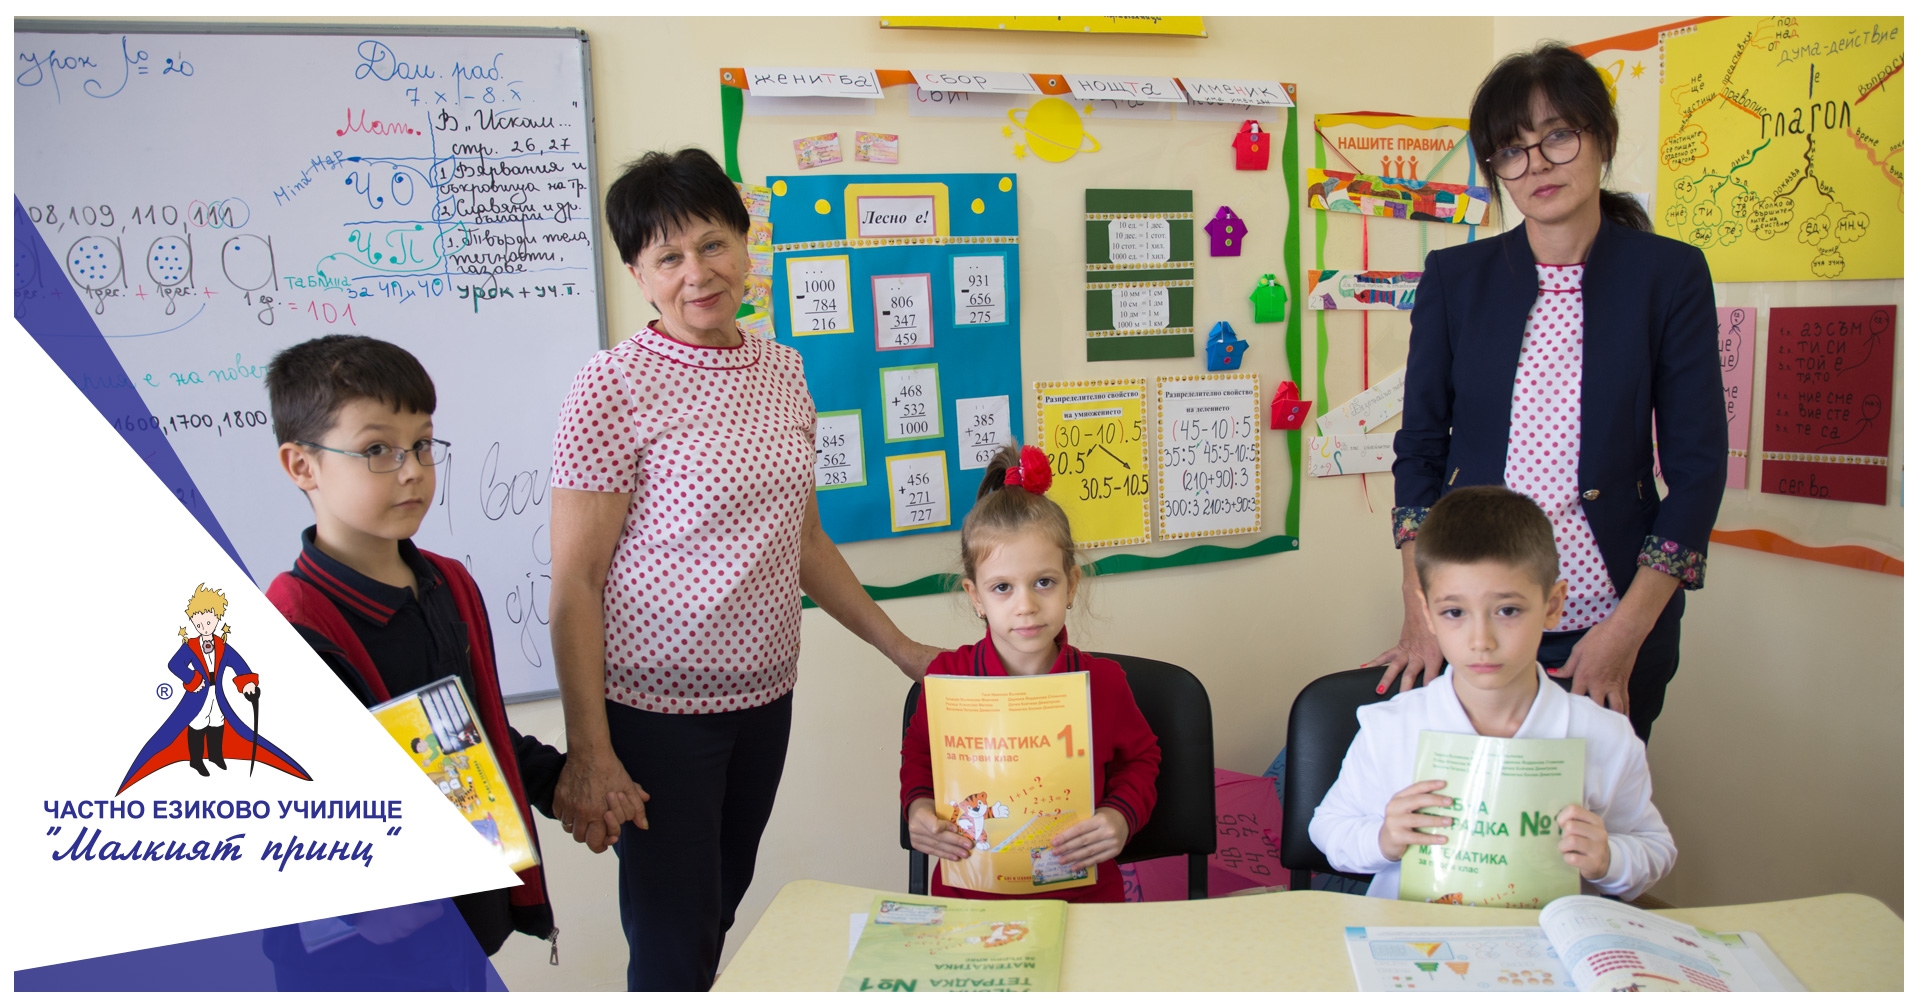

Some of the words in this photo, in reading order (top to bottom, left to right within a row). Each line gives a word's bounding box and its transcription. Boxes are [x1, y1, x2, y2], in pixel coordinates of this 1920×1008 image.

[1761, 101, 1851, 139] глагол
[1338, 136, 1394, 150] НАШИТЕ
[1397, 138, 1454, 151] ПРАВИЛА
[862, 210, 907, 225] Лесно
[915, 210, 929, 225] е!
[804, 279, 836, 294] 1000
[968, 275, 990, 288] 931
[812, 299, 837, 313] 784
[890, 296, 914, 309] 806
[969, 293, 992, 306] 656
[893, 314, 916, 328] 347
[969, 311, 991, 324] 275
[812, 318, 836, 332] 216
[894, 332, 917, 346] 459
[899, 385, 923, 398] 468
[1045, 392, 1106, 403] Разпределително
[1107, 390, 1139, 399] свойство
[1165, 390, 1222, 399] Разпределително
[1223, 388, 1254, 397] свойство
[903, 403, 926, 417] 532
[1064, 411, 1073, 419] на
[1073, 408, 1122, 420] умножението
[1197, 405, 1230, 413] делението
[973, 414, 995, 427] 385
[899, 421, 929, 435] 1000
[822, 435, 845, 448] 845
[974, 432, 996, 445] 247
[823, 453, 847, 467] 562
[824, 471, 848, 485] 283
[907, 473, 930, 487] 456
[909, 491, 930, 505] 271
[910, 509, 932, 522] 727
[944, 735, 1051, 750] МАТЕМАТИКА
[1057, 724, 1085, 758] 1.
[946, 752, 957, 761] за
[959, 752, 991, 764] първи
[994, 752, 1019, 763] клас
[934, 961, 1035, 970] МАТЕМАТИКА
[930, 977, 1032, 988] ТЕТРАДКА
